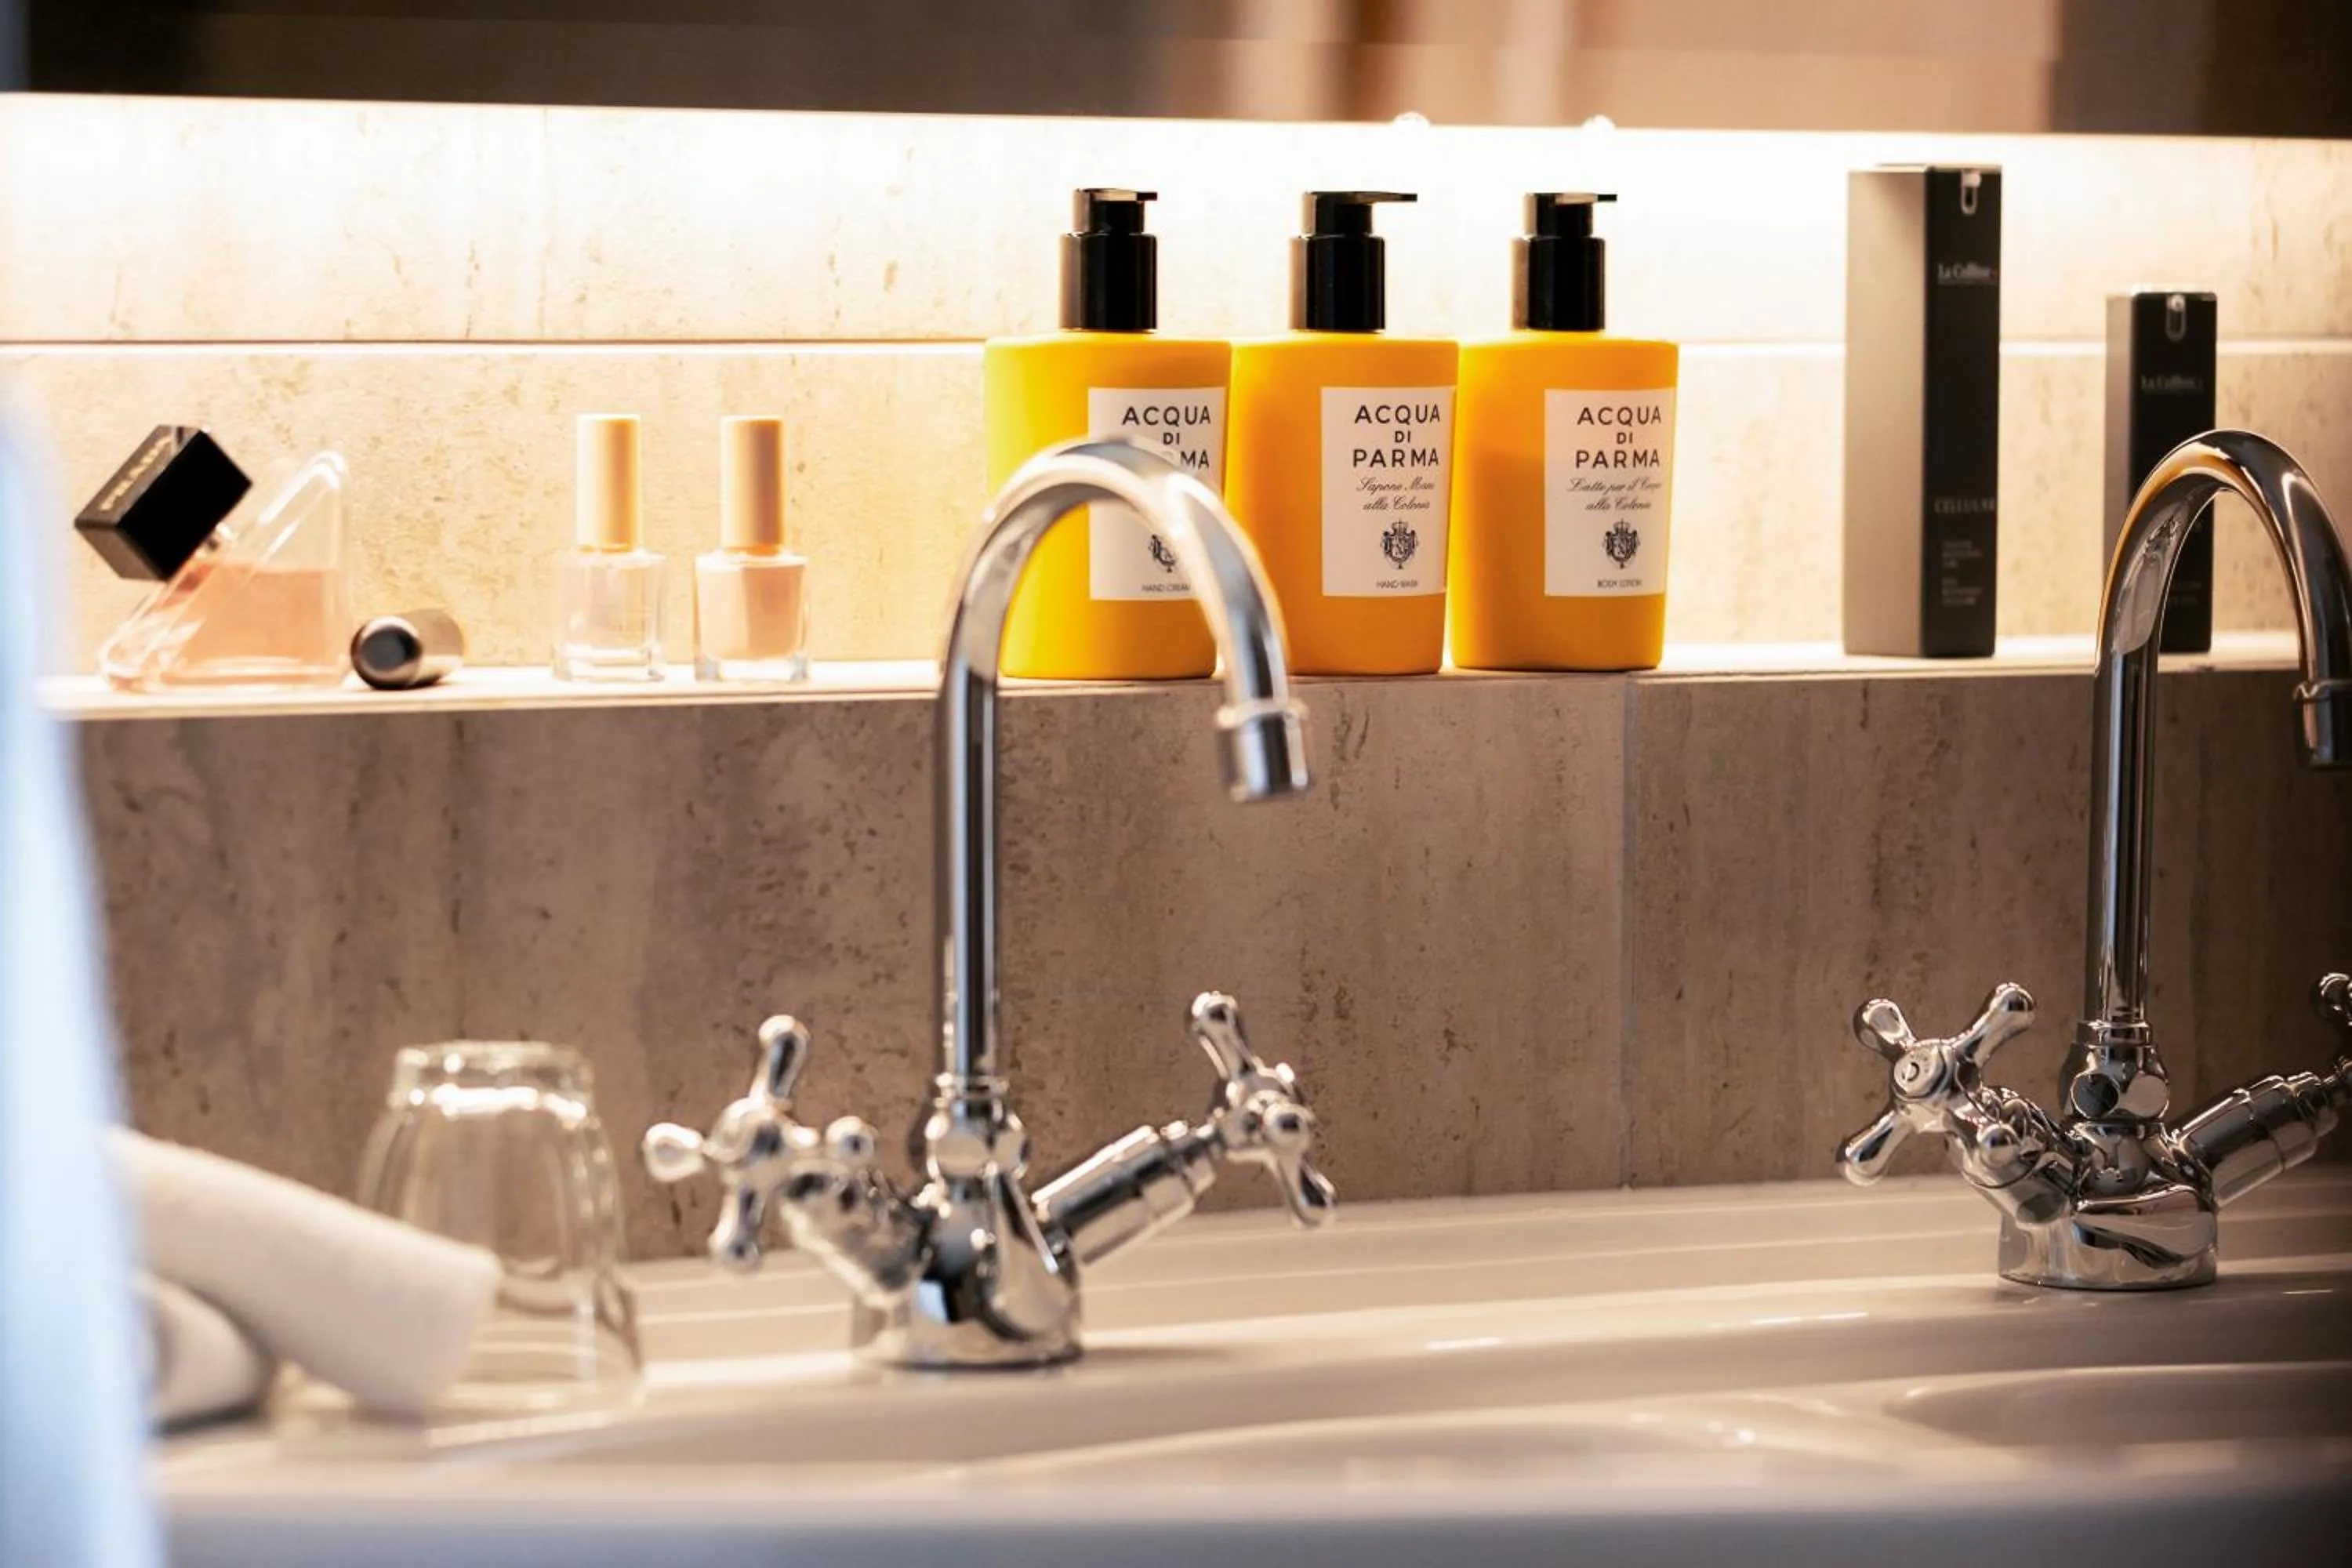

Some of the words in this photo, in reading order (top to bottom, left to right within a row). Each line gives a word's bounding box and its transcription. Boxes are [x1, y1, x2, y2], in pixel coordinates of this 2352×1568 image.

[1122, 405, 1211, 427] ACQUA
[1354, 404, 1441, 425] ACQUA
[1577, 405, 1662, 426] ACQUA
[1163, 431, 1181, 445] DI
[1394, 430, 1411, 444] DI
[1616, 431, 1633, 445] DI
[1352, 448, 1439, 468] PARMA
[1575, 449, 1661, 469] PARMA
